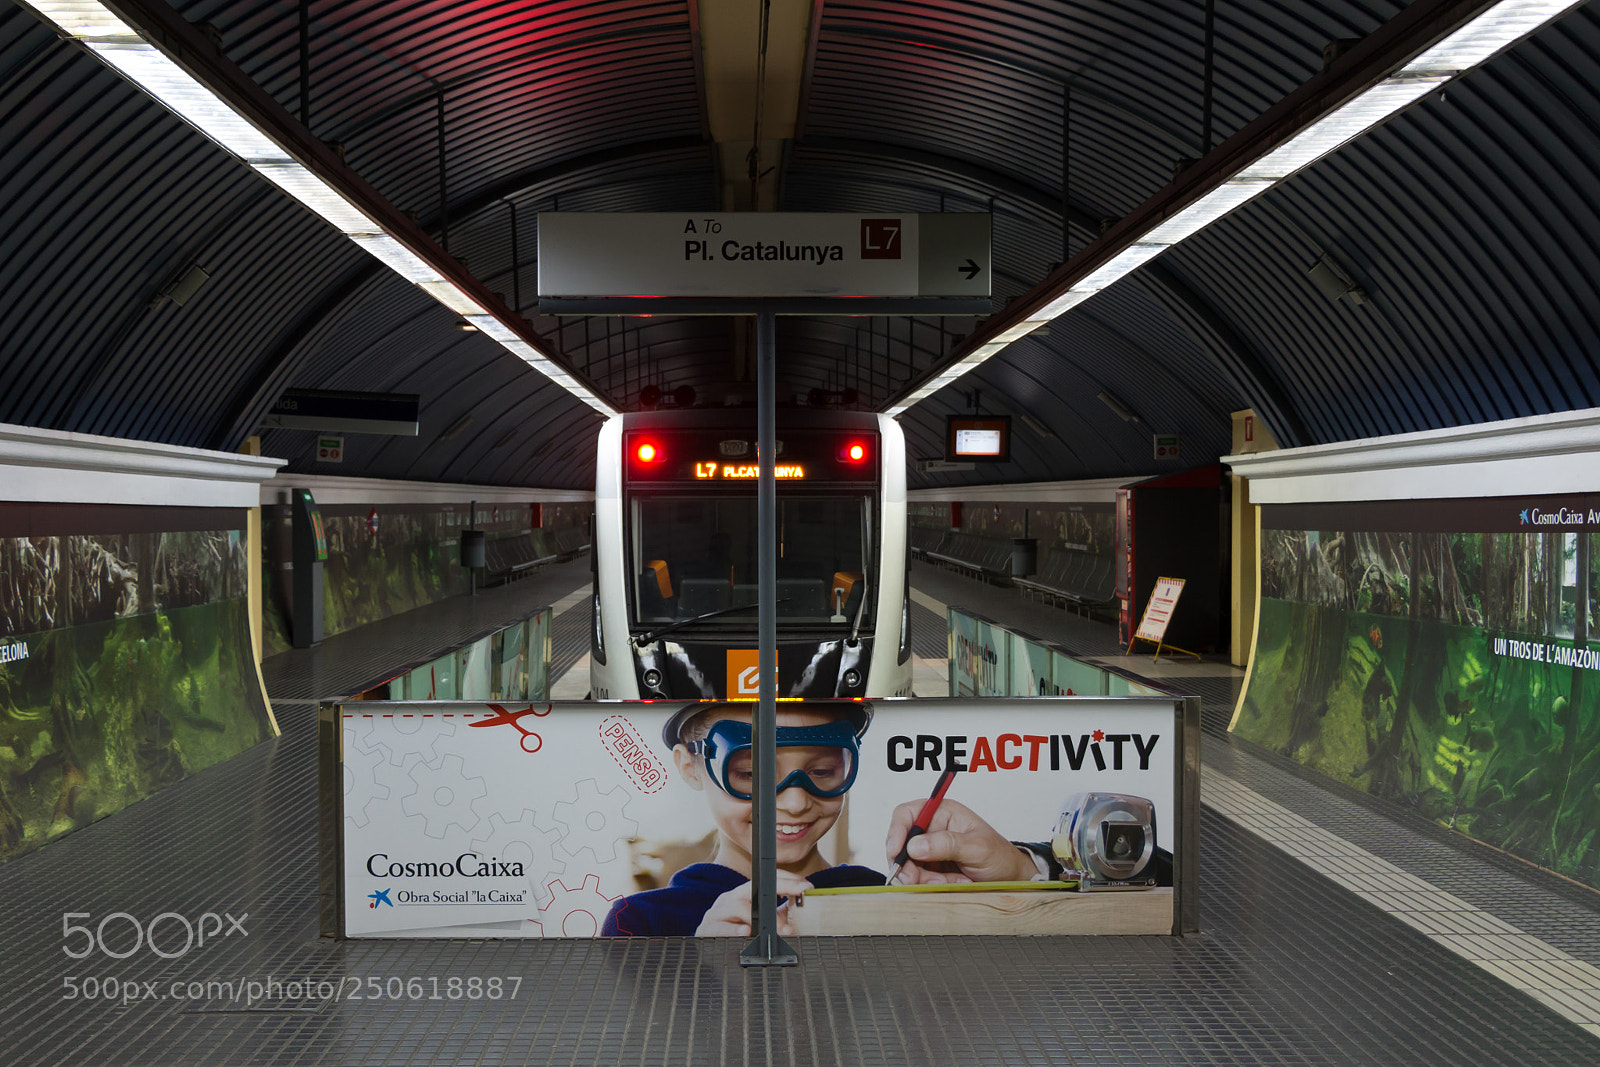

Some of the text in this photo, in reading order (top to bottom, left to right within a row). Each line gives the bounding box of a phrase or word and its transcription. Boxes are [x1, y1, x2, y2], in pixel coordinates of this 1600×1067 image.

[684, 219, 722, 234] A To
[865, 226, 899, 250] L7
[685, 240, 843, 265] Pl. Catalunya
[696, 463, 717, 478] L7
[1532, 507, 1583, 525] CosmoCaixa
[1494, 637, 1507, 656] UN
[1508, 639, 1531, 660] TROS
[1532, 642, 1545, 662] DE
[604, 722, 661, 788] PENSA
[886, 729, 1160, 772] CREACTIVITY
[366, 853, 525, 878] CosmoCaixa
[397, 890, 430, 903] Obra
[432, 890, 469, 903] Social
[488, 889, 527, 903] Caixa"
